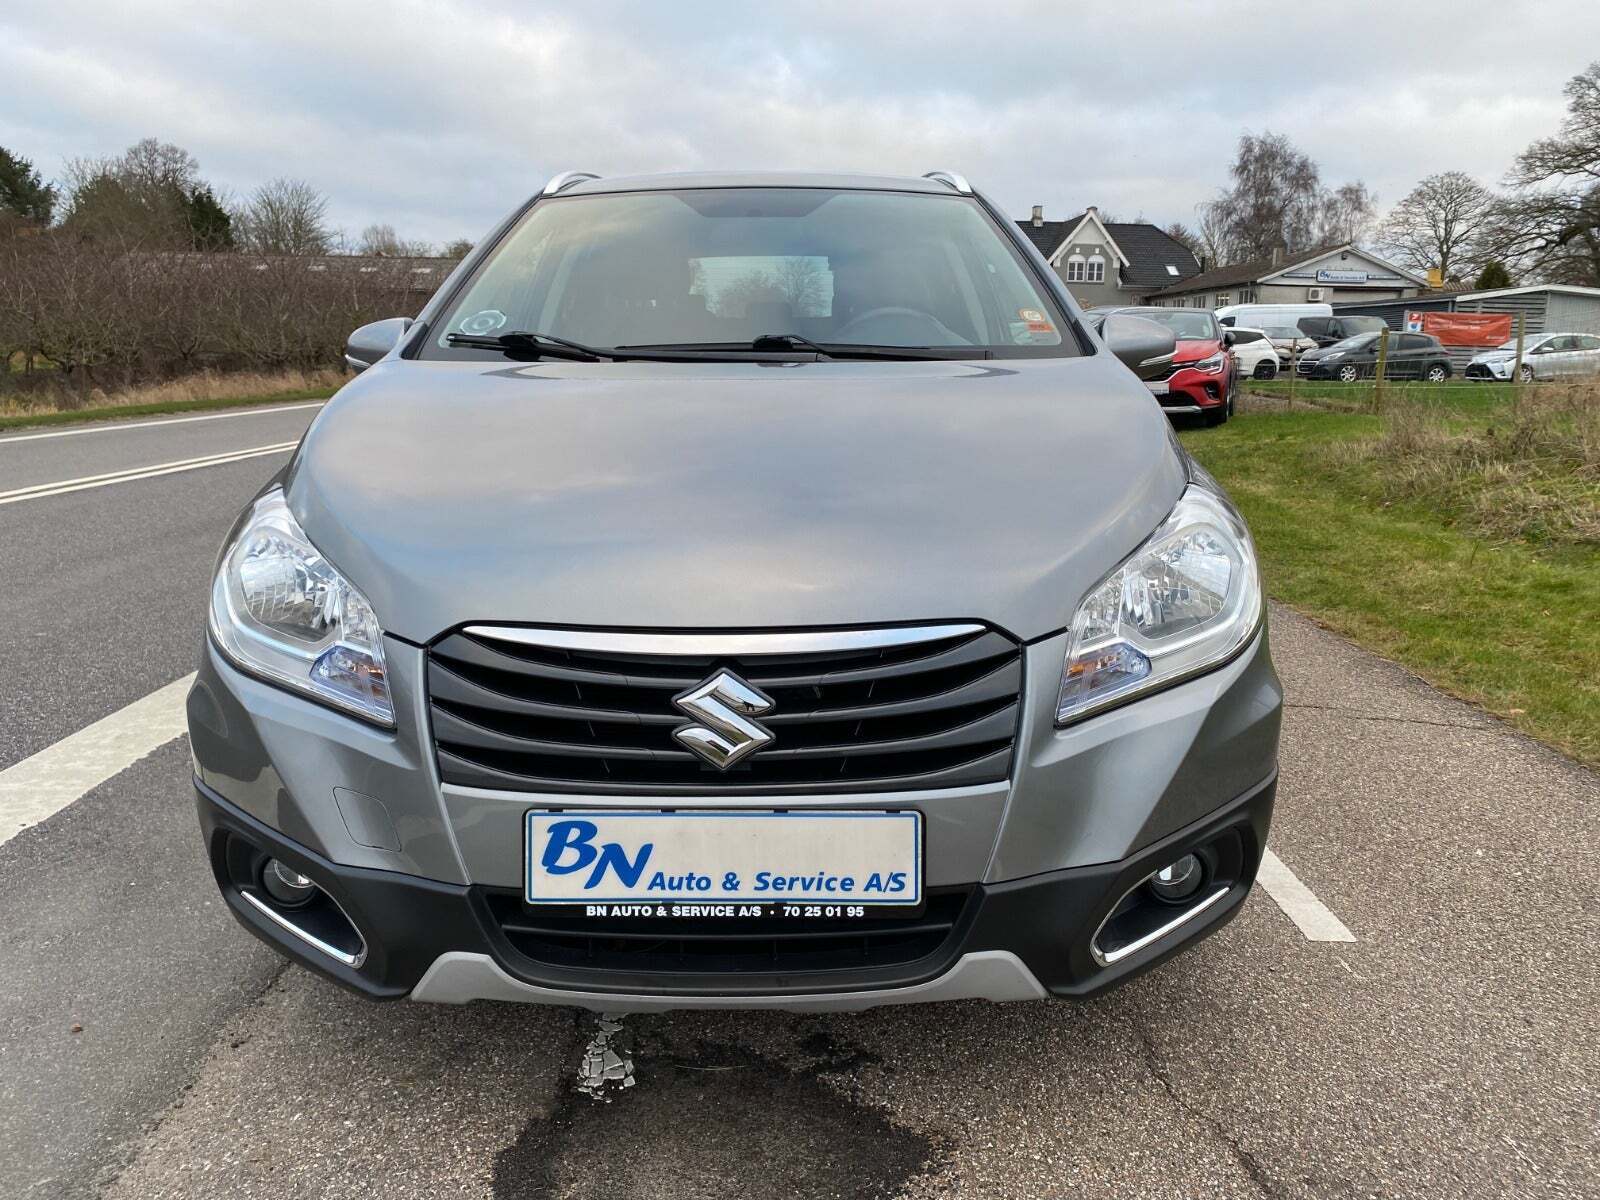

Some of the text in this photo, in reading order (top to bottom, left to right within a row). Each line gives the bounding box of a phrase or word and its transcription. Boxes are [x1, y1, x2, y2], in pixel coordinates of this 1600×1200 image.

[541, 820, 907, 893] BN Auto & Service A/S
[586, 905, 865, 917] BN AUTO & SERVICE A/S 70 25 01 95
